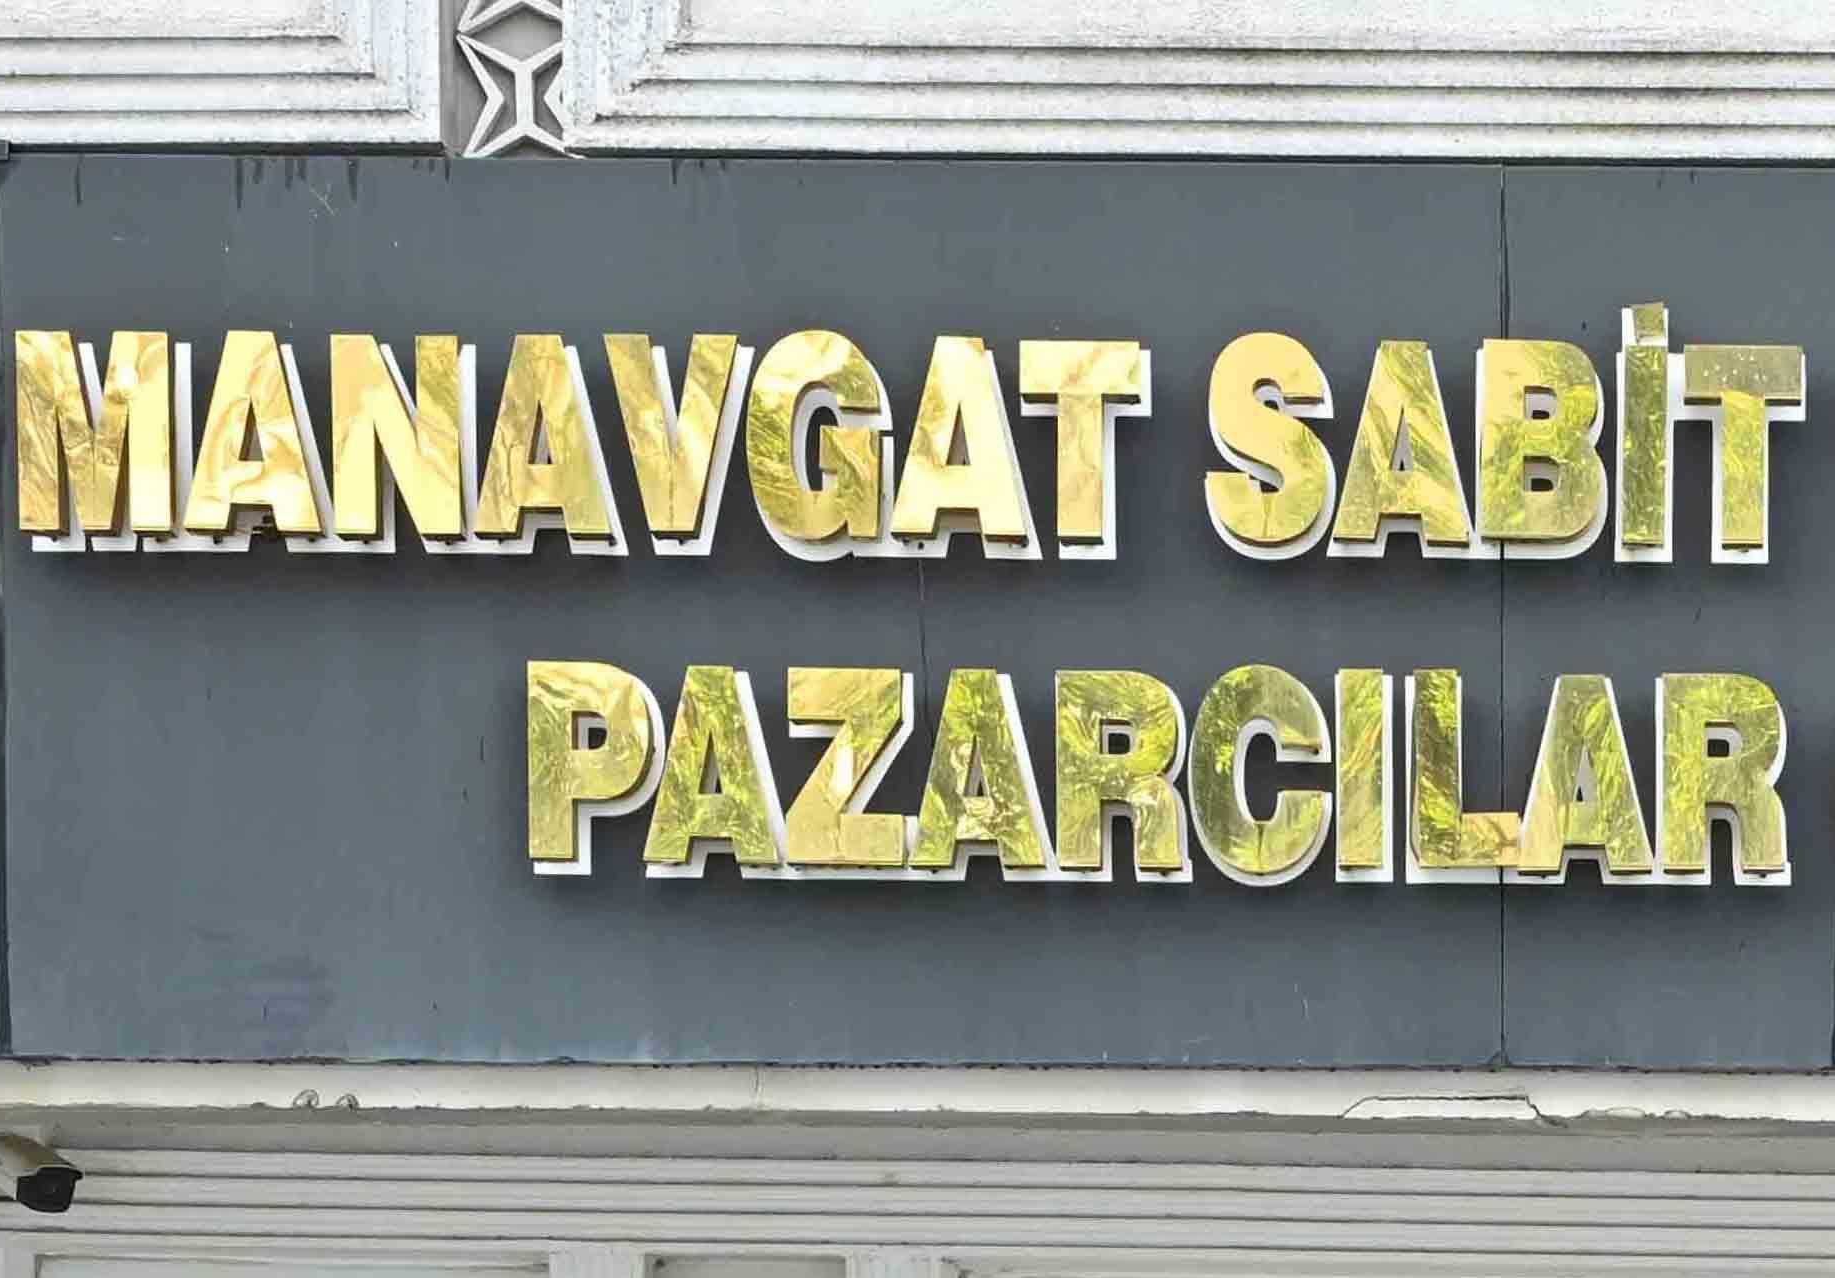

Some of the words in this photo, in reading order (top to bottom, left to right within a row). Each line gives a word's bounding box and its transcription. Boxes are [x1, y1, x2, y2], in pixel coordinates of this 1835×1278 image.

[14, 329, 1153, 561] MANAVGAT
[1204, 303, 1807, 564] SABİT
[526, 659, 1793, 886] PAZARCILAR
